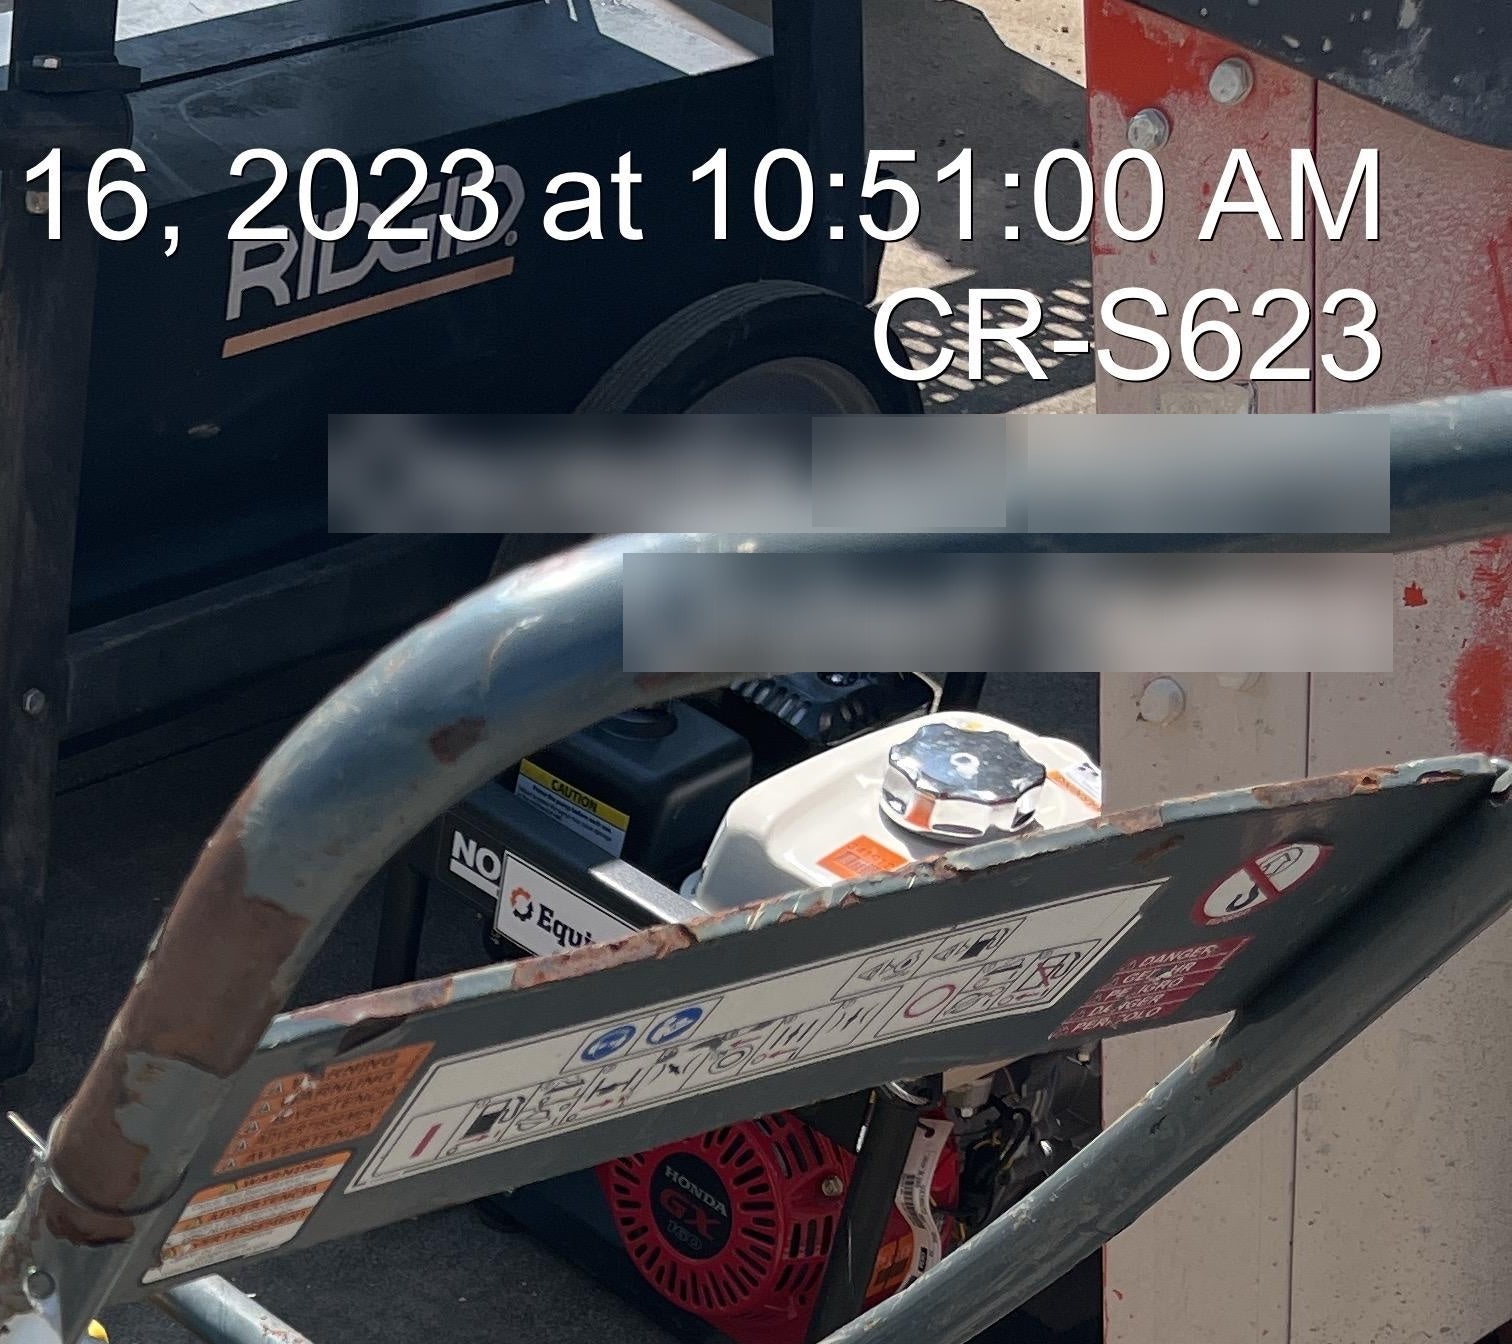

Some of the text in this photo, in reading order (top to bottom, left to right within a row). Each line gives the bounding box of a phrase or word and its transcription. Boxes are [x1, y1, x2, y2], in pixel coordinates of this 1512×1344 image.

[226, 165, 526, 321] RIDGID
[551, 779, 598, 813] CAUTION
[1138, 943, 1219, 968] DANGER
[1104, 975, 1185, 999] PEIGRO
[664, 1165, 728, 1218] HONDA
[660, 1187, 721, 1242] GX
